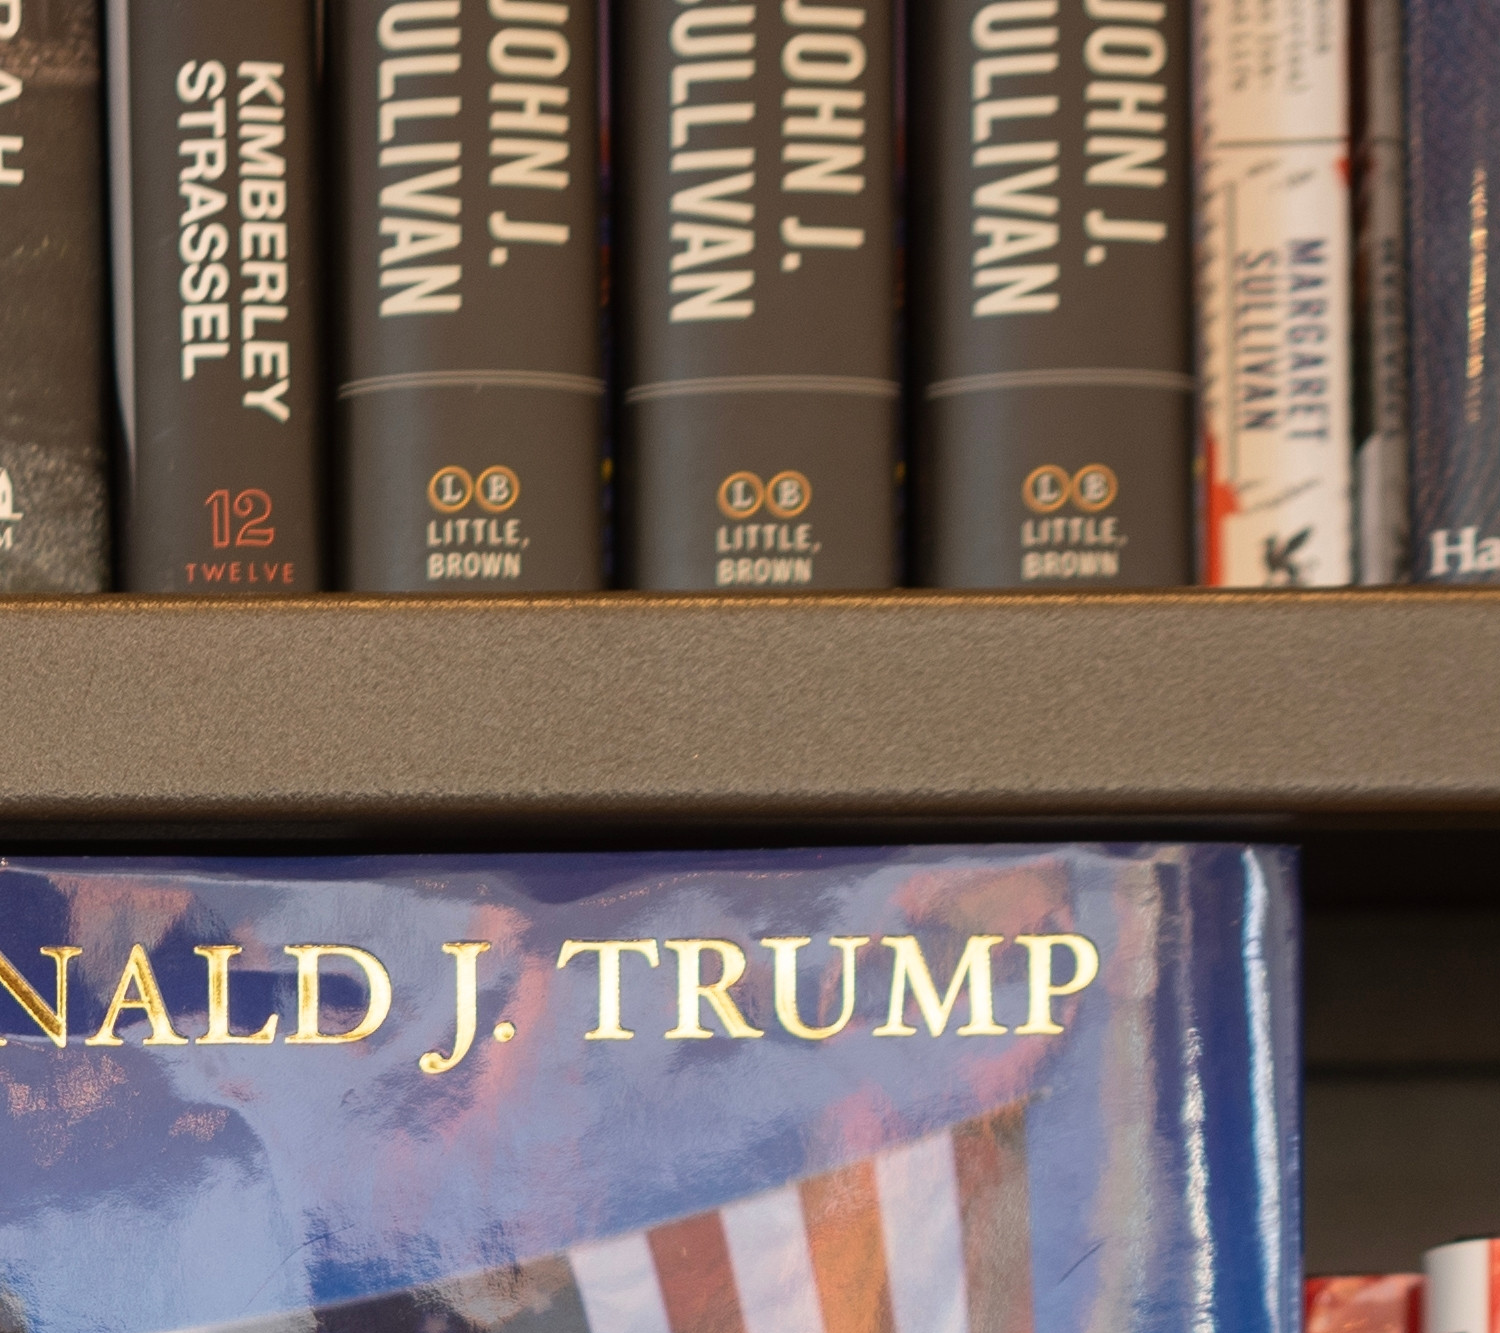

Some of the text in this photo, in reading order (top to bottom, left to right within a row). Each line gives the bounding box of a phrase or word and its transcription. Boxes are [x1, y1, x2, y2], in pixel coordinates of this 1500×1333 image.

[175, 60, 231, 381] STRASSEL
[236, 61, 292, 425] KIMBERLEY
[487, 210, 572, 268] J.
[780, 214, 867, 274] J.
[1083, 208, 1168, 268] J.
[1234, 249, 1280, 432] SULLIVAN
[1286, 238, 1330, 443] MARGARET
[427, 519, 529, 550] LITTLE,
[716, 525, 821, 555] LITTLE,
[1021, 518, 1129, 548] LITTLE,
[186, 562, 296, 584] TWELVE
[427, 553, 522, 581] BROWN
[716, 559, 813, 586] BROWN
[1021, 551, 1119, 581] BROWN
[417, 943, 518, 1075] J.
[556, 932, 1103, 1046] TRUMP
